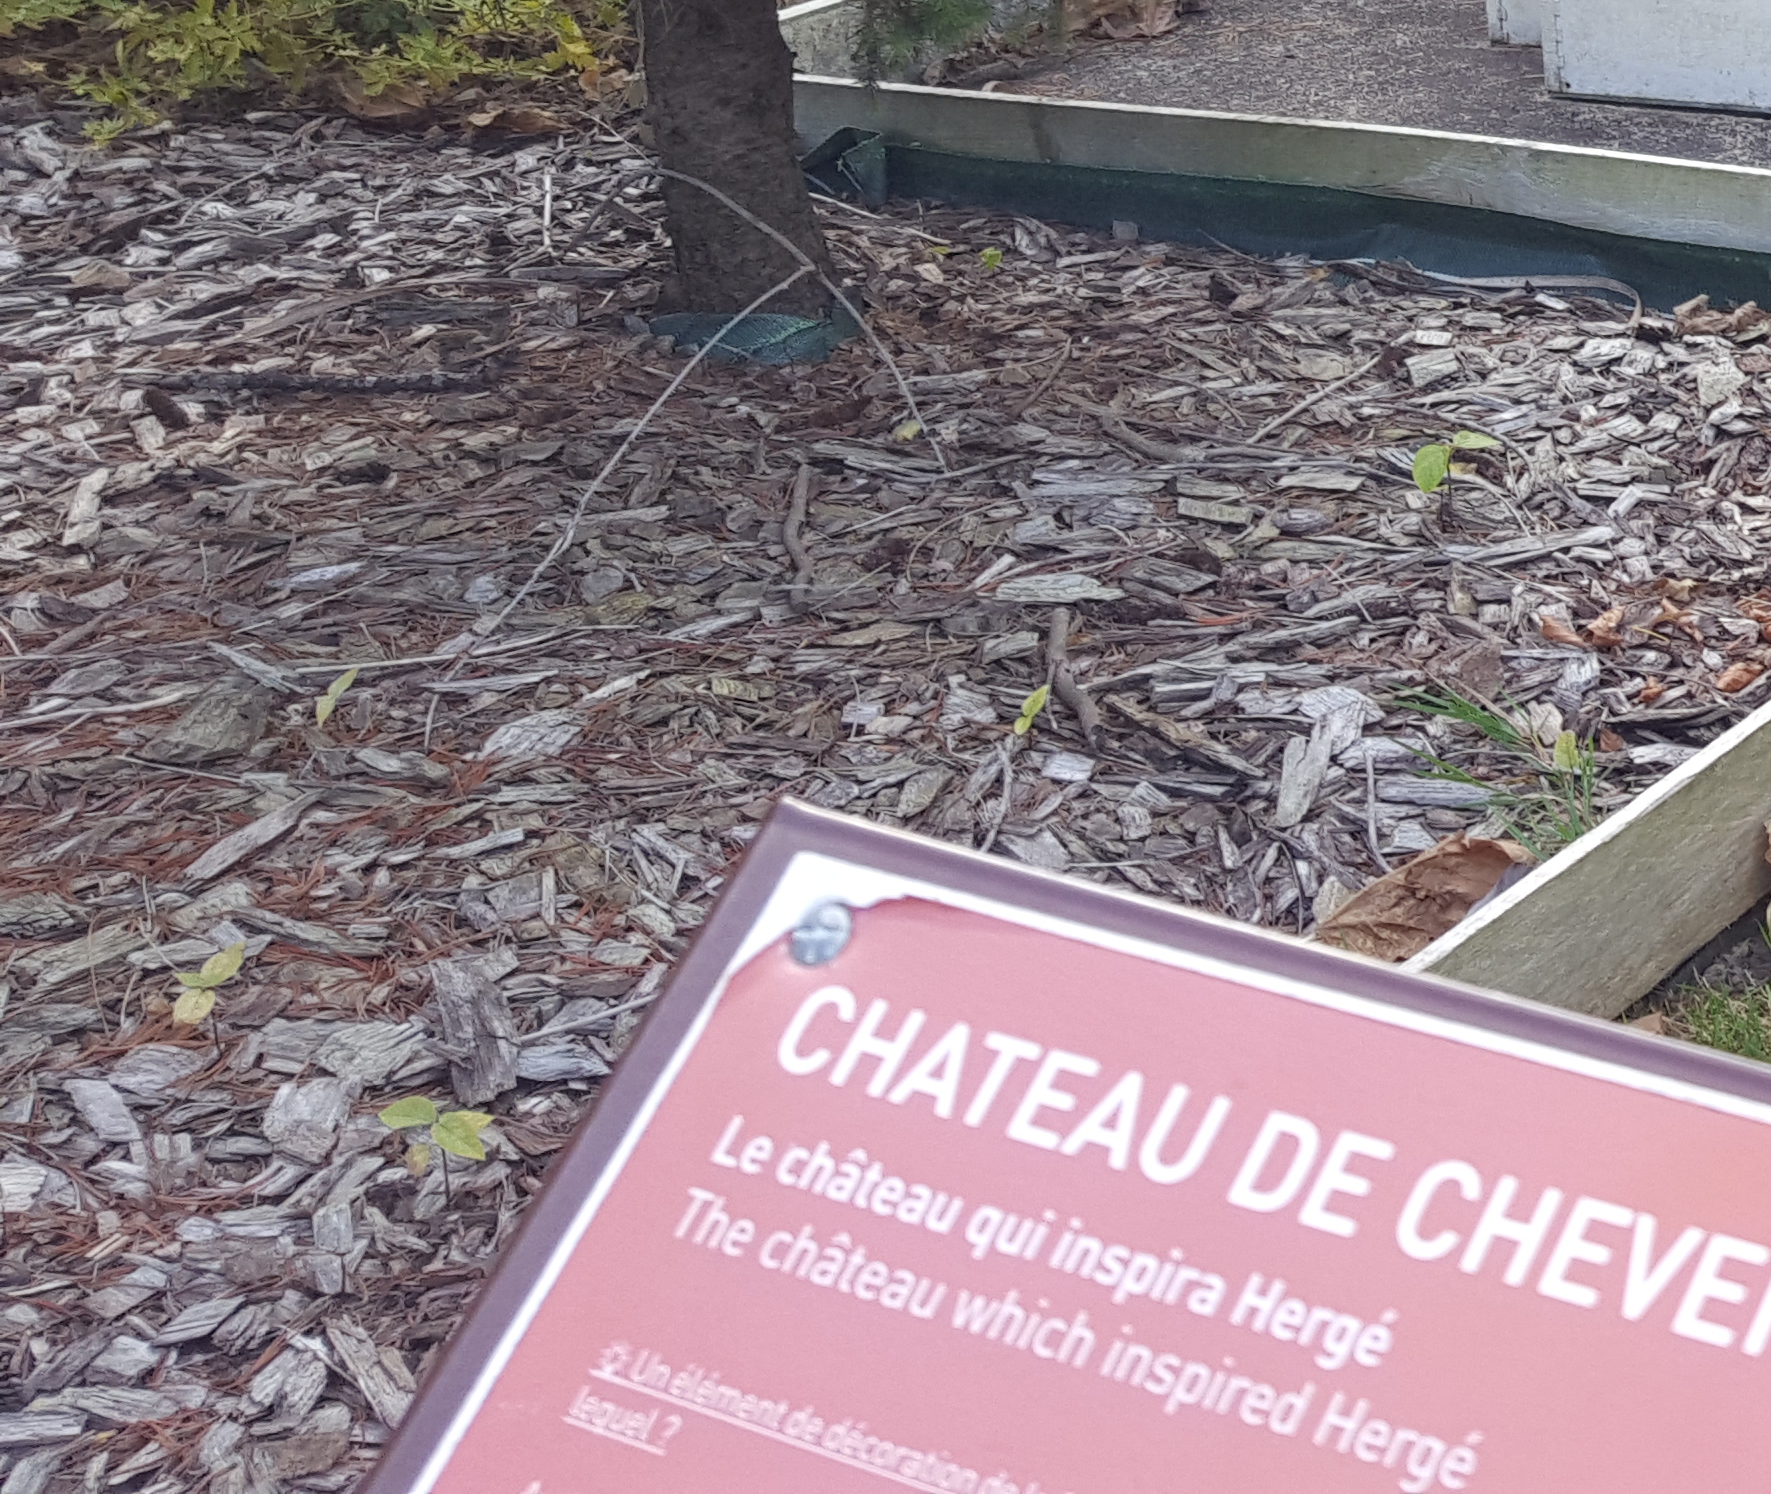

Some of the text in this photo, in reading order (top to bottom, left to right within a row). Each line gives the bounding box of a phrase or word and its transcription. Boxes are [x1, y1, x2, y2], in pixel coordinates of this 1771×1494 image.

[776, 986, 1233, 1184] CHATEAU
[1226, 1109, 1396, 1238] DE
[673, 1186, 1485, 1494] The château which inspired Hergé
[710, 1113, 1399, 1371] Le château qui inspira Hergé
[782, 1405, 826, 1444] de
